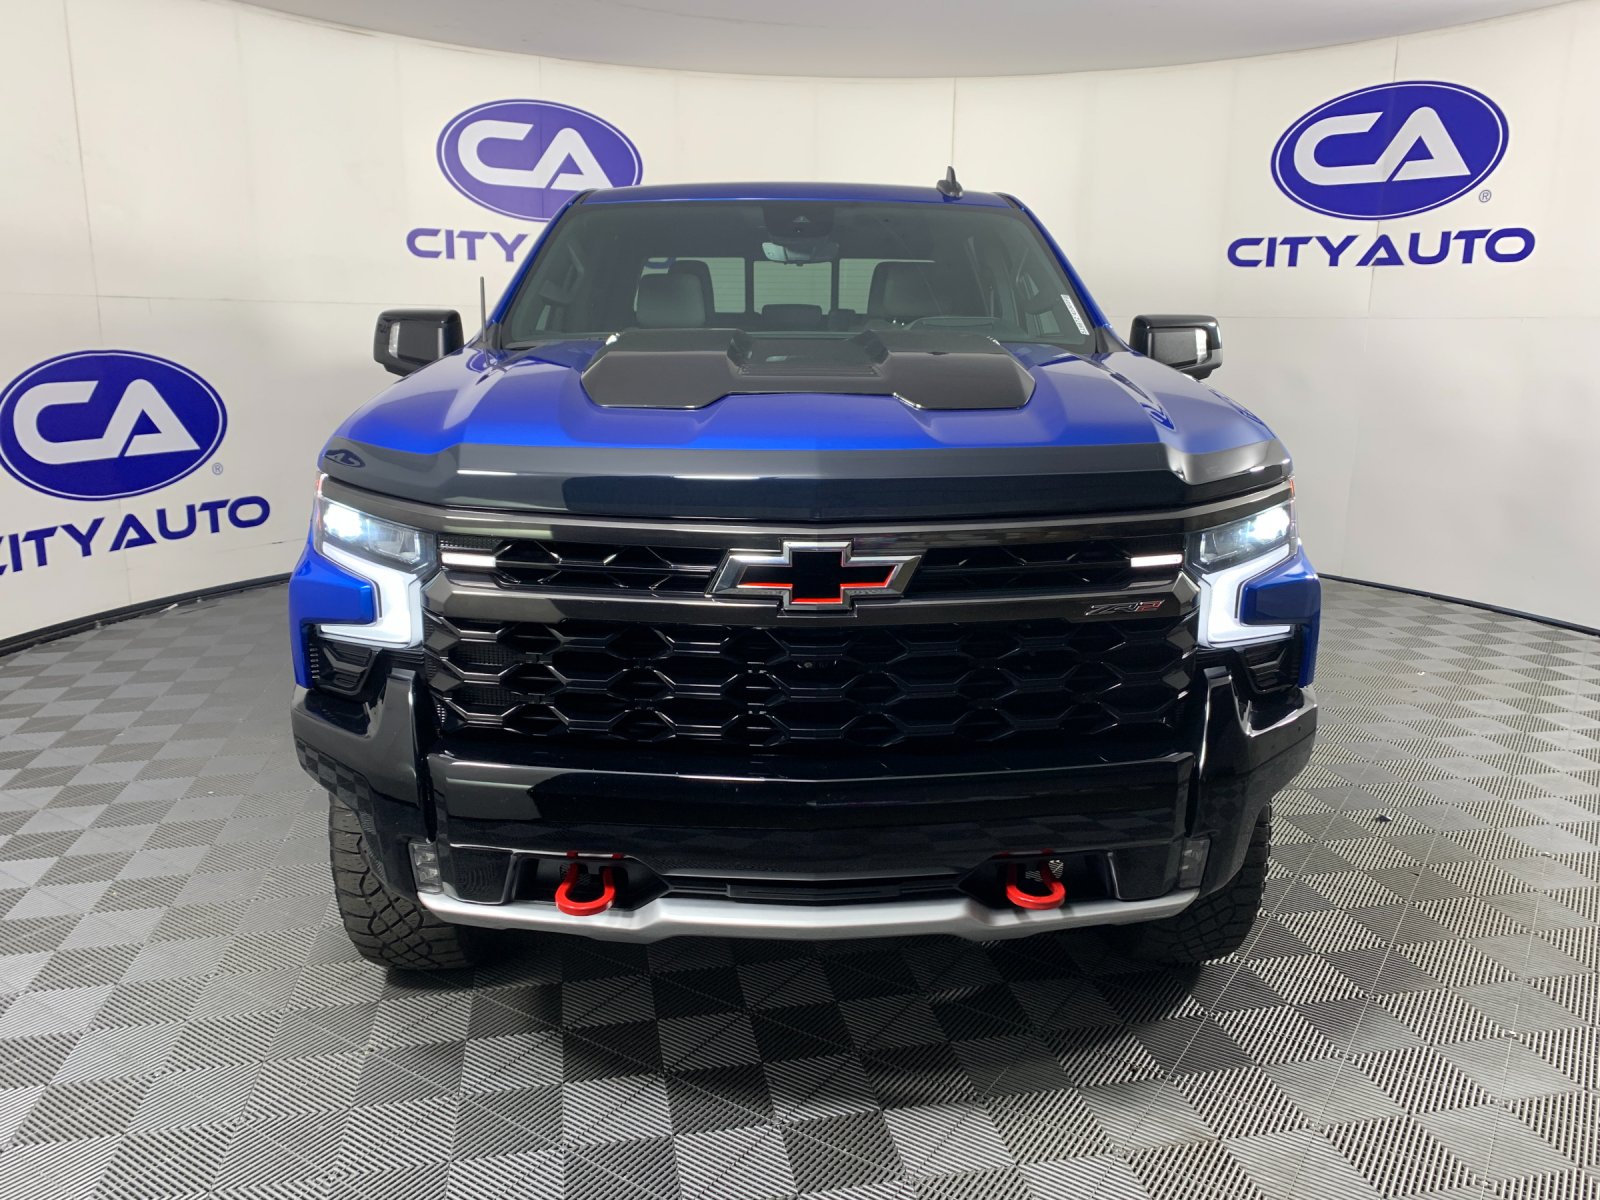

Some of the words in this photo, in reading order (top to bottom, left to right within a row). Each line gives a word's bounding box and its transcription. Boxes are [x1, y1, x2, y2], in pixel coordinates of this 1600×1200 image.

[458, 119, 614, 191] CA
[1294, 106, 1471, 186] CA
[406, 227, 529, 262] CITY
[1227, 235, 1360, 267] CITY
[1355, 227, 1536, 267] AUTO
[13, 378, 201, 465] CA
[109, 496, 271, 553] AUTO
[1084, 599, 1165, 616] ZR2
